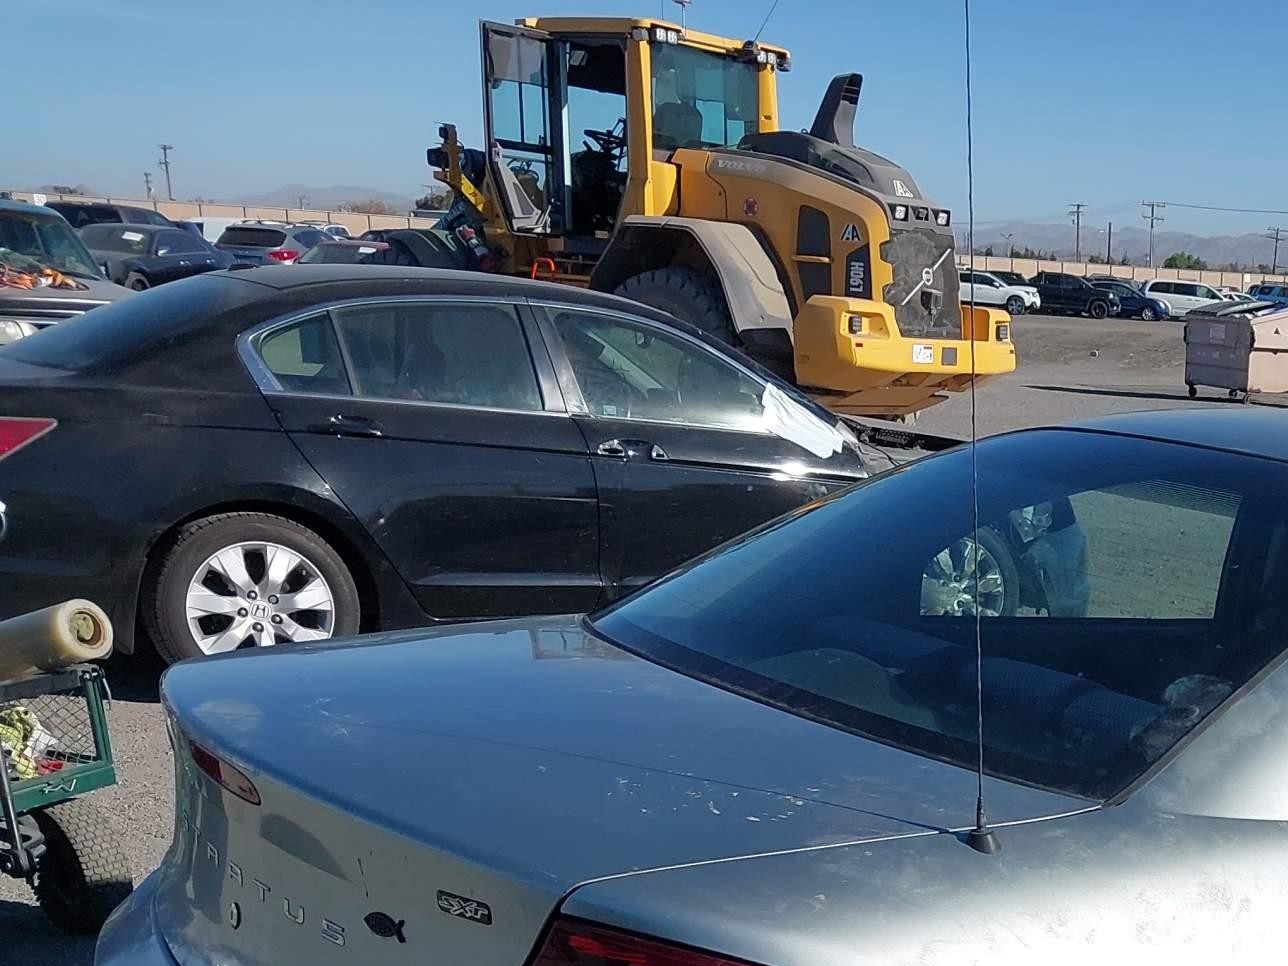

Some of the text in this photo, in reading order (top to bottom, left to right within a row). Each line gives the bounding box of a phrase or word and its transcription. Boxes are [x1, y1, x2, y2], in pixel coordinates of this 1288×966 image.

[717, 159, 766, 173] VOLVO
[849, 261, 865, 293] L90H
[438, 895, 489, 919] SXT
